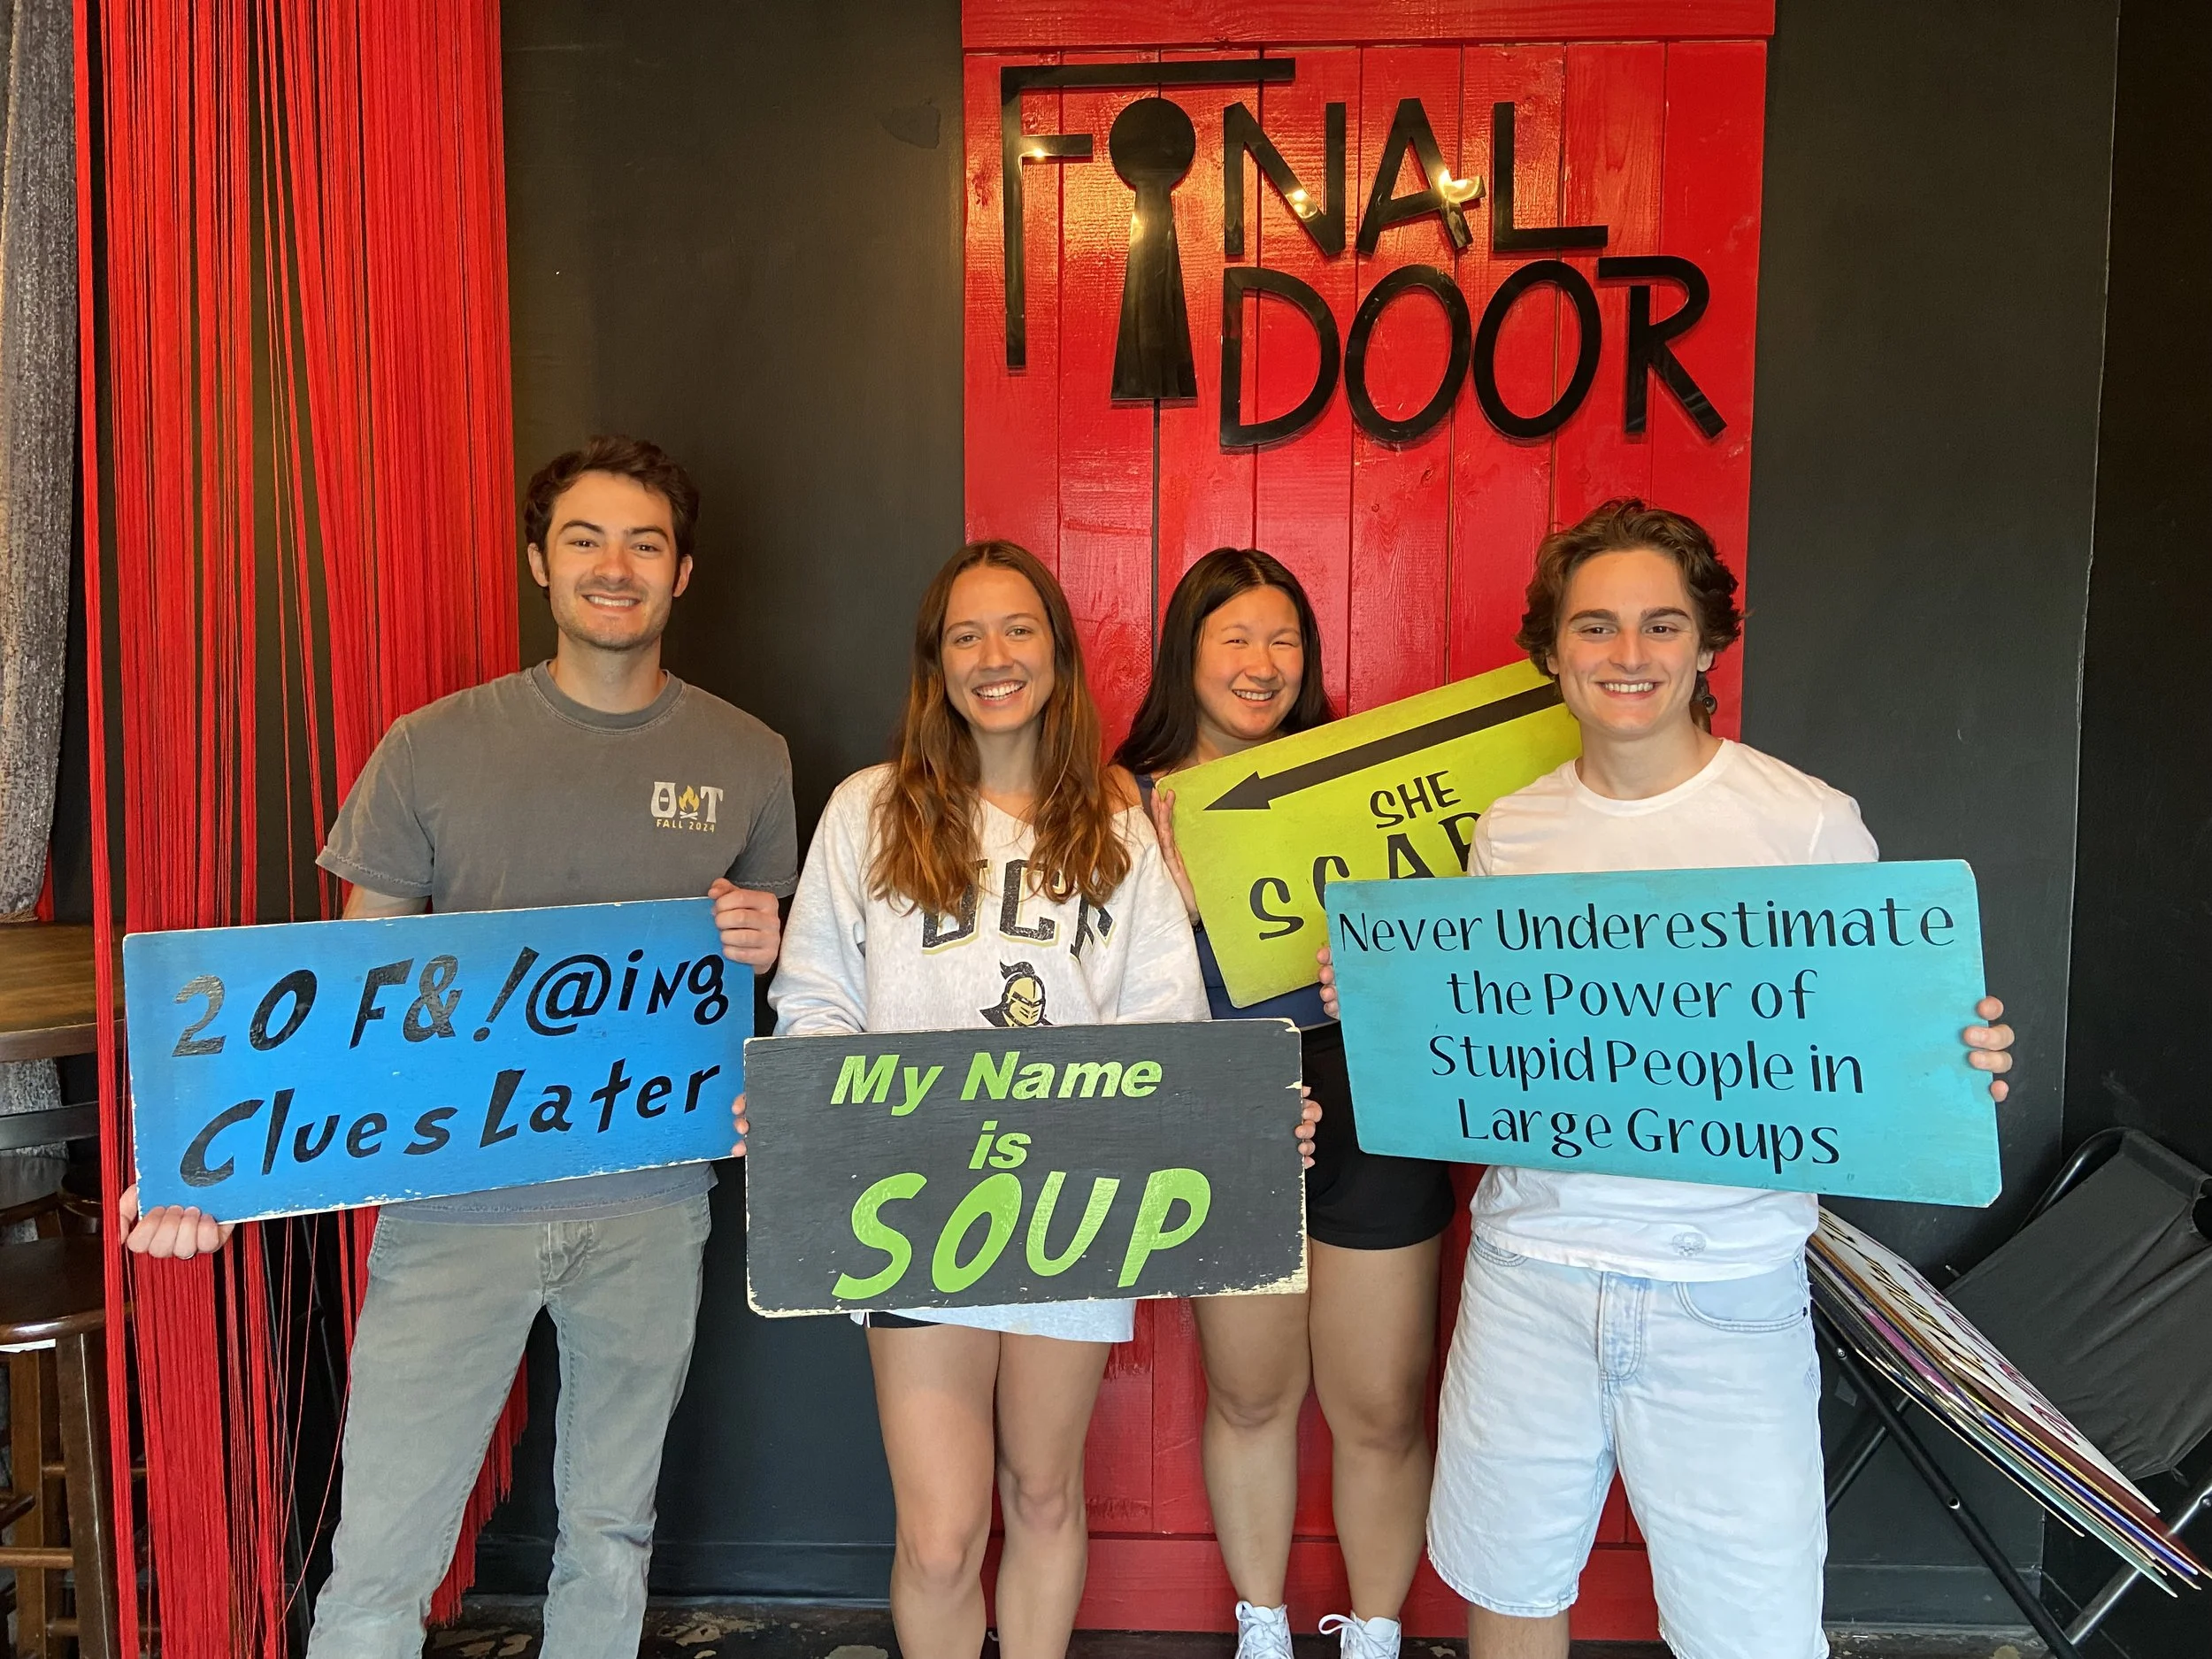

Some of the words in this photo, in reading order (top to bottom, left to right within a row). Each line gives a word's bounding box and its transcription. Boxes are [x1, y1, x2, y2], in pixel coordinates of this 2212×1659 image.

[1219, 255, 1728, 449] DOOR
[657, 819, 683, 829] FALL
[688, 821, 716, 833] 2024
[1371, 770, 1461, 828] SHE
[1339, 911, 1484, 953] Never
[1495, 897, 1955, 951] Underestimate
[1446, 969, 1532, 1017] the
[1544, 972, 1733, 1019] Power
[1750, 969, 1818, 1020] of
[829, 1054, 944, 1118] My
[960, 1050, 1164, 1102] Name
[1428, 1034, 1595, 1092] Stupid
[1607, 1040, 1794, 1102] People
[1811, 1044, 1864, 1094] in
[179, 1087, 460, 1187] Clues
[478, 1057, 721, 1150] Later
[968, 1119, 1033, 1171] is
[1458, 1097, 1613, 1159] Large
[1627, 1106, 1841, 1174] Groups
[831, 1167, 1212, 1301] SOUP
